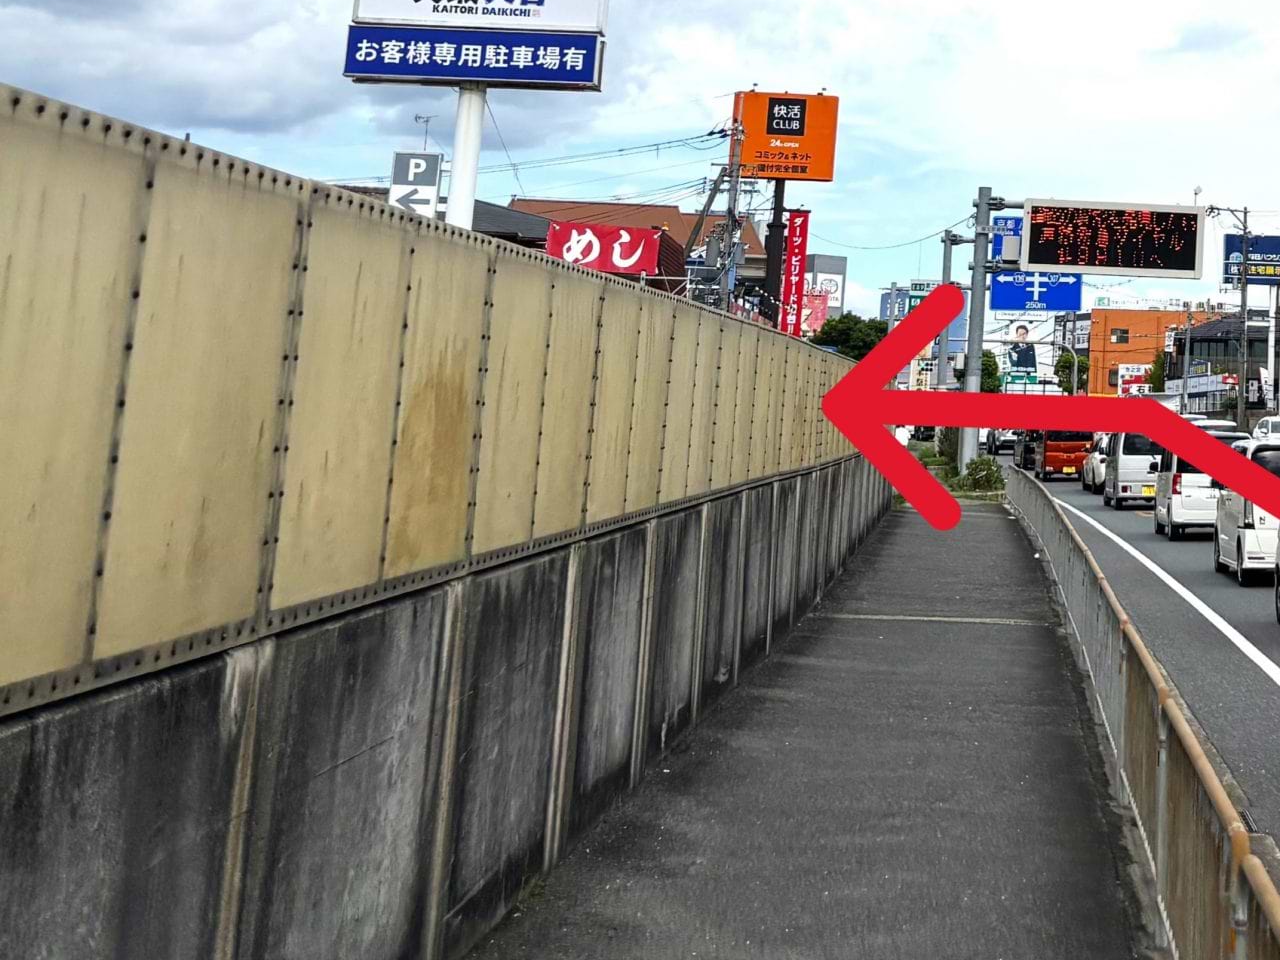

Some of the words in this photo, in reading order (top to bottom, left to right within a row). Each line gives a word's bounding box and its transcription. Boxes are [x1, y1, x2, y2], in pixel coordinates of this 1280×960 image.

[432, 5, 478, 15] KAITORI
[482, 7, 531, 17] DAIKICHI
[355, 40, 587, 71] お客様専用駐車場有
[773, 104, 801, 118] 快活
[773, 120, 800, 129] CLUB
[408, 158, 426, 181] P
[562, 228, 646, 266] めし
